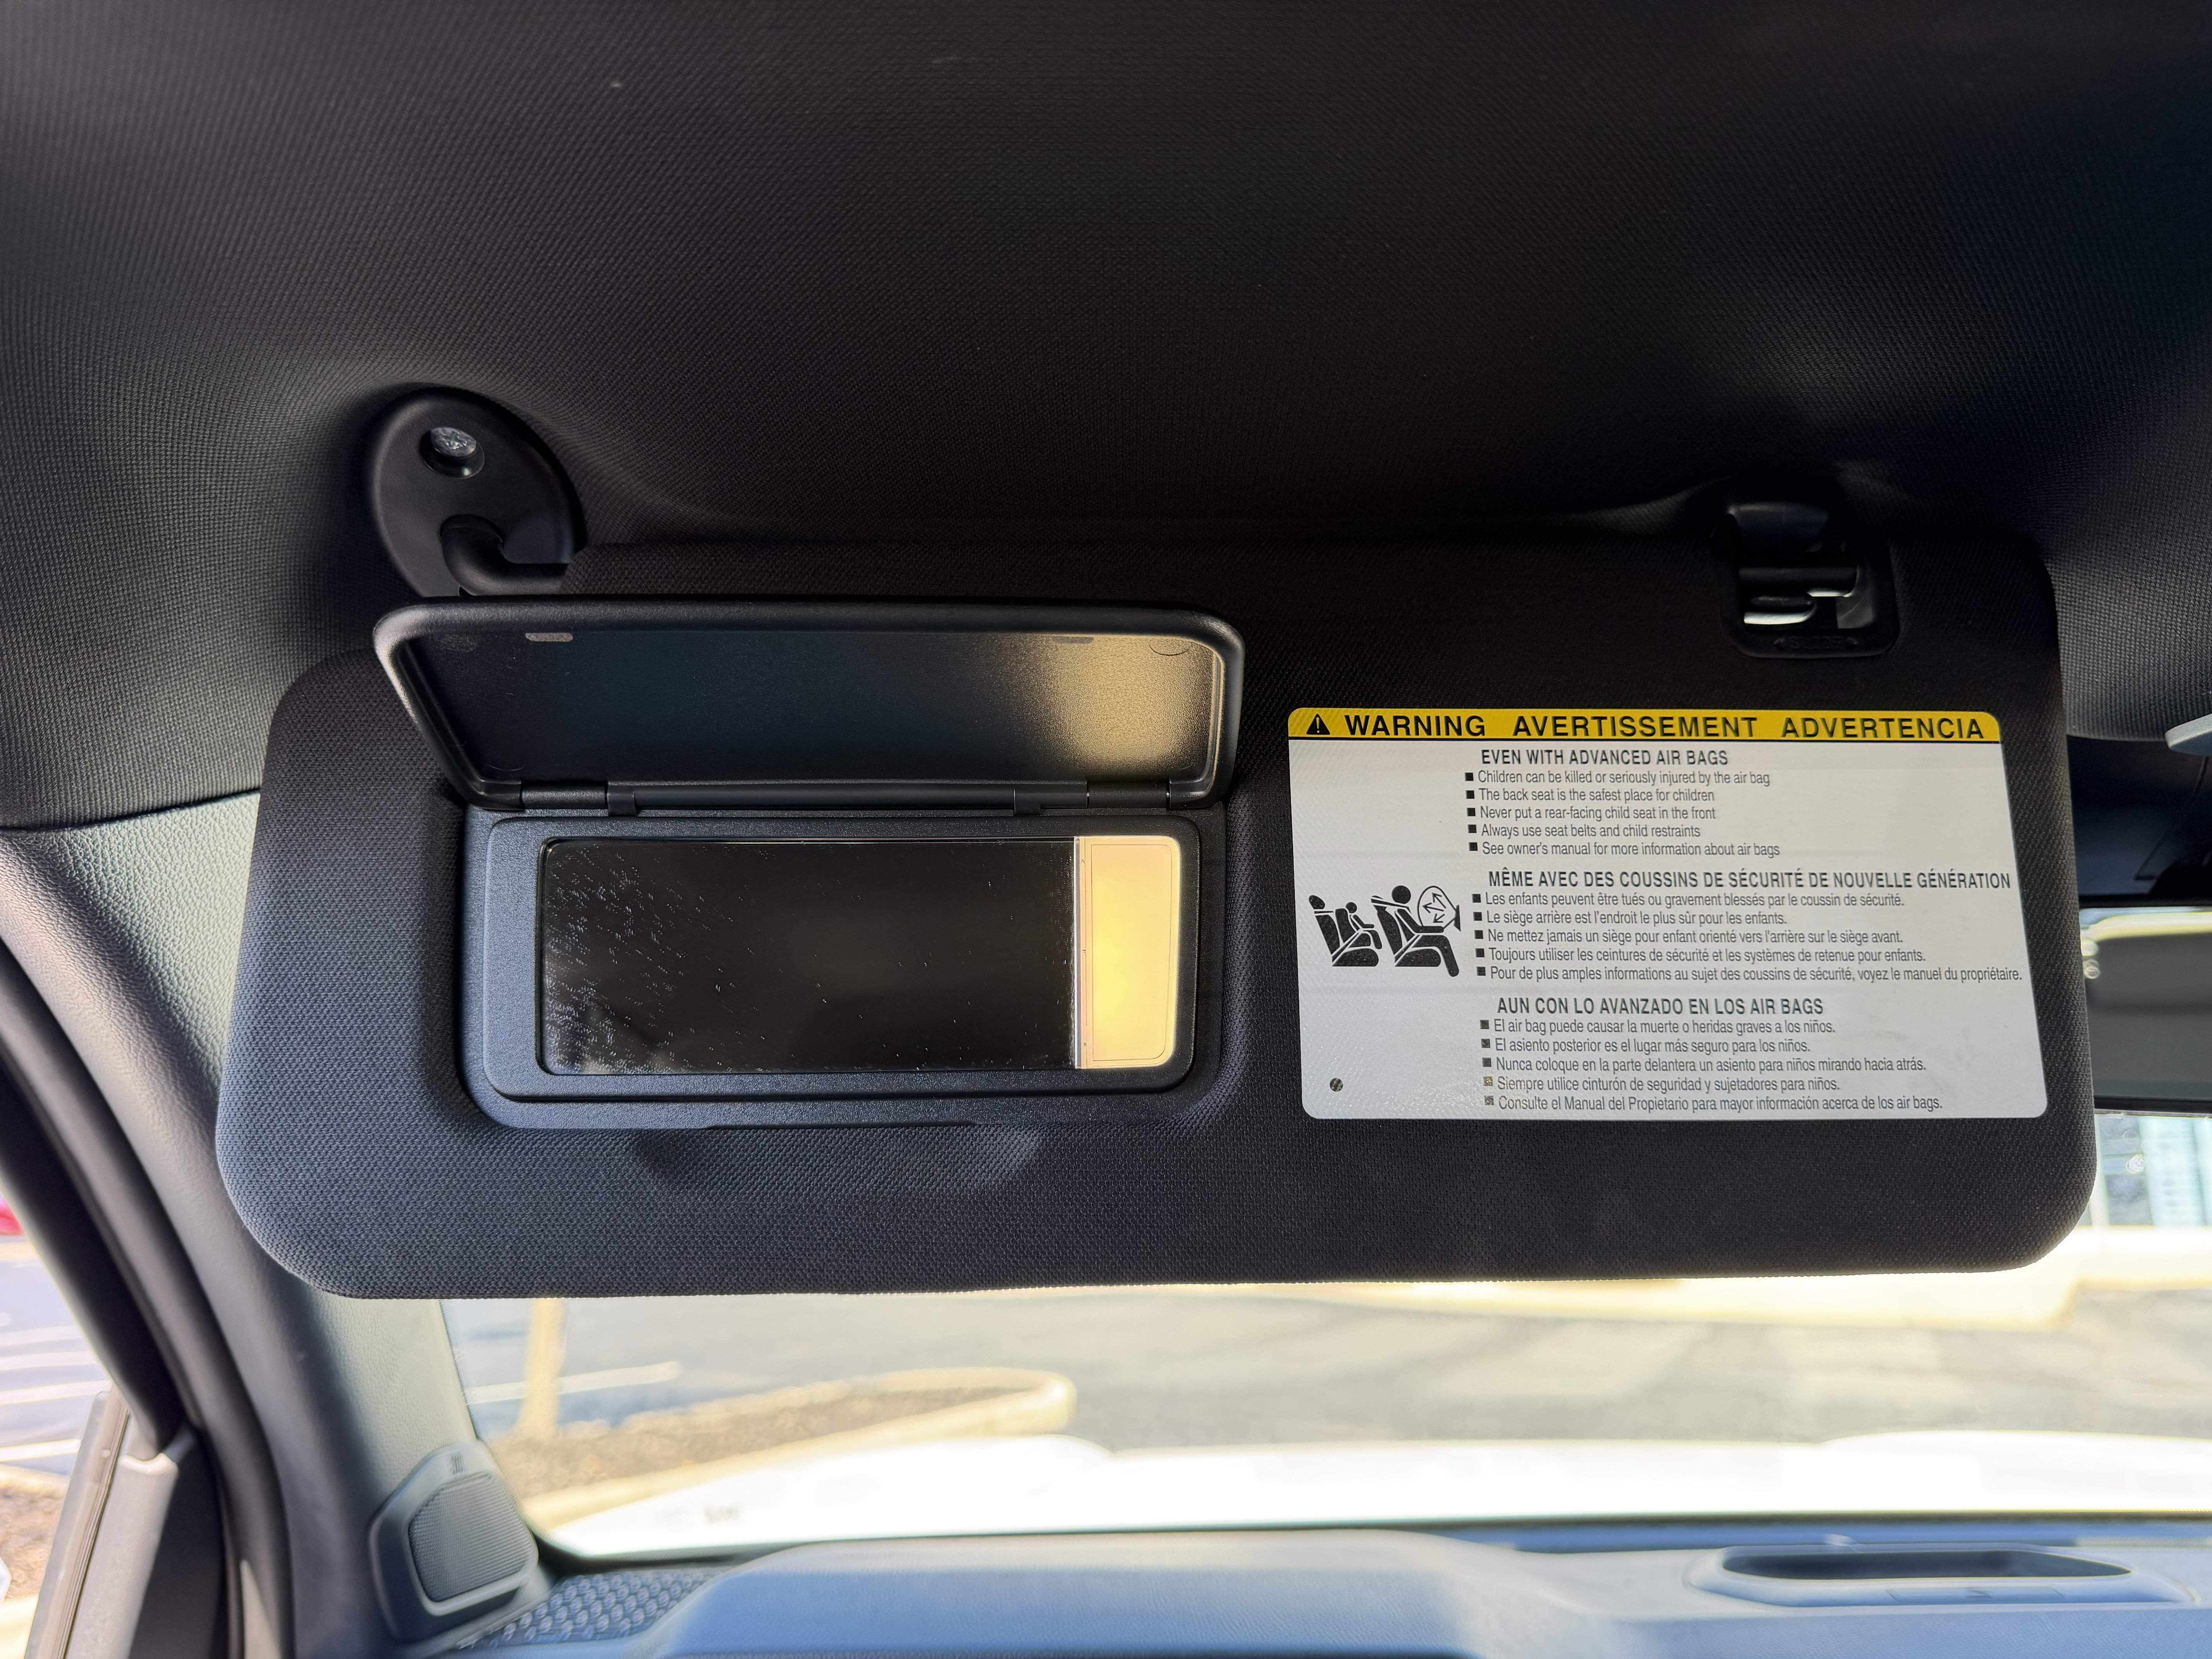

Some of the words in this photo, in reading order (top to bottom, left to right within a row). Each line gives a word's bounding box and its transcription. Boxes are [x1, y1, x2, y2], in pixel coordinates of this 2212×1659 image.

[1344, 715, 1485, 737] WARNING
[1513, 716, 1757, 737] AVERTISSEMENT
[1782, 717, 1984, 739] ADVERTENCIA
[1481, 749, 1521, 764] EVEN
[1526, 749, 1564, 764] WITH
[1569, 750, 1651, 765] ADVANCED
[1657, 750, 1681, 765] AIR
[1686, 750, 1728, 765] BAGS
[1478, 769, 1523, 783] Children
[1525, 773, 1545, 783] can
[1548, 770, 1562, 783] be
[1565, 770, 1592, 783] killed
[1595, 773, 1607, 783] or
[1609, 771, 1656, 787] seriously
[1659, 771, 1696, 787] injured
[1698, 771, 1711, 787] by
[1714, 771, 1731, 784] the
[1733, 771, 1747, 783] air
[1749, 771, 1770, 787] bag
[1478, 788, 1500, 801] The
[1503, 788, 1529, 801] back
[1531, 789, 1555, 801] seat
[1557, 788, 1566, 801] is
[1569, 788, 1586, 801] the
[1589, 788, 1621, 801] safest
[1624, 788, 1653, 804] place
[1656, 788, 1670, 801] for
[1673, 788, 1714, 801] children
[1480, 805, 1512, 819] Never
[1515, 806, 1532, 822] put
[1535, 809, 1542, 819] a
[1545, 805, 1602, 822] rear-facing
[1605, 806, 1630, 819] child
[1633, 807, 1656, 819] seat
[1659, 806, 1668, 819] in
[1671, 806, 1688, 819] the
[1691, 806, 1716, 819] front
[1481, 823, 1519, 840] Always
[1522, 826, 1542, 837] use
[1544, 824, 1568, 837] seat
[1570, 824, 1597, 837] belts
[1599, 824, 1620, 837] and
[1623, 824, 1648, 837] child
[1651, 824, 1700, 837] restraints
[1489, 867, 1534, 886] MÊME
[1538, 871, 1578, 887] AVEC
[1583, 871, 1614, 887] DES
[1620, 871, 1698, 888] COUSSINS
[1704, 872, 1724, 887] DE
[1729, 868, 1804, 888] SÉCURITÉ
[1809, 872, 1829, 888] DE
[1833, 872, 1912, 888] NOUVELLE
[1917, 868, 2010, 888] GÉNÉRATION
[1485, 891, 1506, 905] Les
[1508, 891, 1549, 905] enfants
[1551, 893, 1595, 908] peuvent
[1597, 892, 1619, 905] être
[1621, 892, 1645, 905] tués
[1648, 895, 1662, 906] ou
[1664, 894, 1722, 909] gravement
[1724, 892, 1765, 906] blessés
[1768, 896, 1786, 909] par
[1788, 893, 1798, 906] le
[1800, 893, 1841, 906] coussin
[1843, 893, 1857, 906] de
[1860, 893, 1904, 906] sécurité.
[1488, 928, 1504, 942] Ne
[1507, 929, 1544, 942] mettez
[1546, 929, 1582, 945] jamais
[1585, 932, 1599, 942] un
[1602, 929, 1632, 946] siège
[1635, 932, 1660, 946] pour
[1662, 929, 1697, 943] enfant
[1699, 929, 1737, 943] orienté
[1739, 933, 1763, 943] vers
[1765, 929, 1805, 943] l'arrière
[1808, 933, 1825, 943] sur
[1827, 930, 1838, 943] le
[1840, 929, 1869, 946] siège
[1871, 931, 1903, 943] avant.
[1488, 947, 1536, 964] Toujours
[1539, 947, 1574, 961] utiliser
[1577, 947, 1594, 961] les
[1596, 948, 1646, 961] ceintures
[1649, 948, 1663, 961] de
[1666, 948, 1709, 962] sécurité
[1712, 949, 1723, 962] et
[1725, 948, 1741, 962] les
[1744, 948, 1795, 965] systèmes
[1798, 948, 1812, 962] de
[1814, 949, 1855, 962] retenue
[1858, 951, 1882, 965] pour
[1884, 948, 1925, 962] enfants.
[1497, 997, 1530, 1014] AUN
[1535, 997, 1568, 1014] CON
[1574, 998, 1594, 1014] LO
[1599, 998, 1683, 1015] AVANZADO
[1689, 998, 1709, 1014] EN
[1714, 998, 1745, 1015] LOS
[1750, 998, 1776, 1014] AIR
[1781, 998, 1823, 1015] BAGS
[1494, 1018, 1505, 1032] El
[1508, 1018, 1522, 1032] air
[1525, 1018, 1546, 1036] bag
[1549, 1019, 1584, 1036] puede
[1587, 1022, 1625, 1033] causar
[1627, 1019, 1638, 1033] la
[1640, 1020, 1679, 1033] muerte
[1682, 1022, 1689, 1033] o
[1692, 1019, 1733, 1033] heridas
[1736, 1022, 1772, 1037] graves
[1775, 1022, 1783, 1033] a
[1784, 1019, 1801, 1033] los
[1803, 1019, 1835, 1033] niños.
[1495, 1037, 1506, 1051] El
[1509, 1037, 1549, 1052] asiento
[1553, 1038, 1601, 1055] posterior
[1604, 1041, 1618, 1052] es
[1621, 1038, 1631, 1052] el
[1633, 1038, 1662, 1056] lugar
[1664, 1038, 1688, 1052] más
[1691, 1041, 1729, 1056] seguro
[1732, 1041, 1757, 1055] para
[1759, 1039, 1776, 1052] los
[1778, 1038, 1810, 1052] niños.
[1496, 1056, 1533, 1071] Nunca
[1535, 1057, 1579, 1074] coloque
[1582, 1060, 1596, 1071] en
[1599, 1057, 1610, 1071] la
[1612, 1058, 1642, 1074] parte
[1644, 1058, 1697, 1072] delantera
[1699, 1061, 1713, 1072] un
[1716, 1058, 1756, 1072] asiento
[1759, 1061, 1784, 1075] para
[1786, 1058, 1815, 1071] niños
[1818, 1057, 1862, 1071] mirando
[1864, 1057, 1894, 1071] hacia
[1896, 1056, 1926, 1070] atrás.
[1498, 1076, 1544, 1093] Siempre
[1547, 1076, 1579, 1091] utilice
[1582, 1077, 1627, 1091] cinturón
[1630, 1077, 1644, 1091] de
[1647, 1077, 1702, 1094] seguridad
[1704, 1080, 1711, 1094] y
[1714, 1077, 1778, 1094] sujetadores
[1780, 1080, 1805, 1094] para
[1808, 1077, 1840, 1090] niños.
